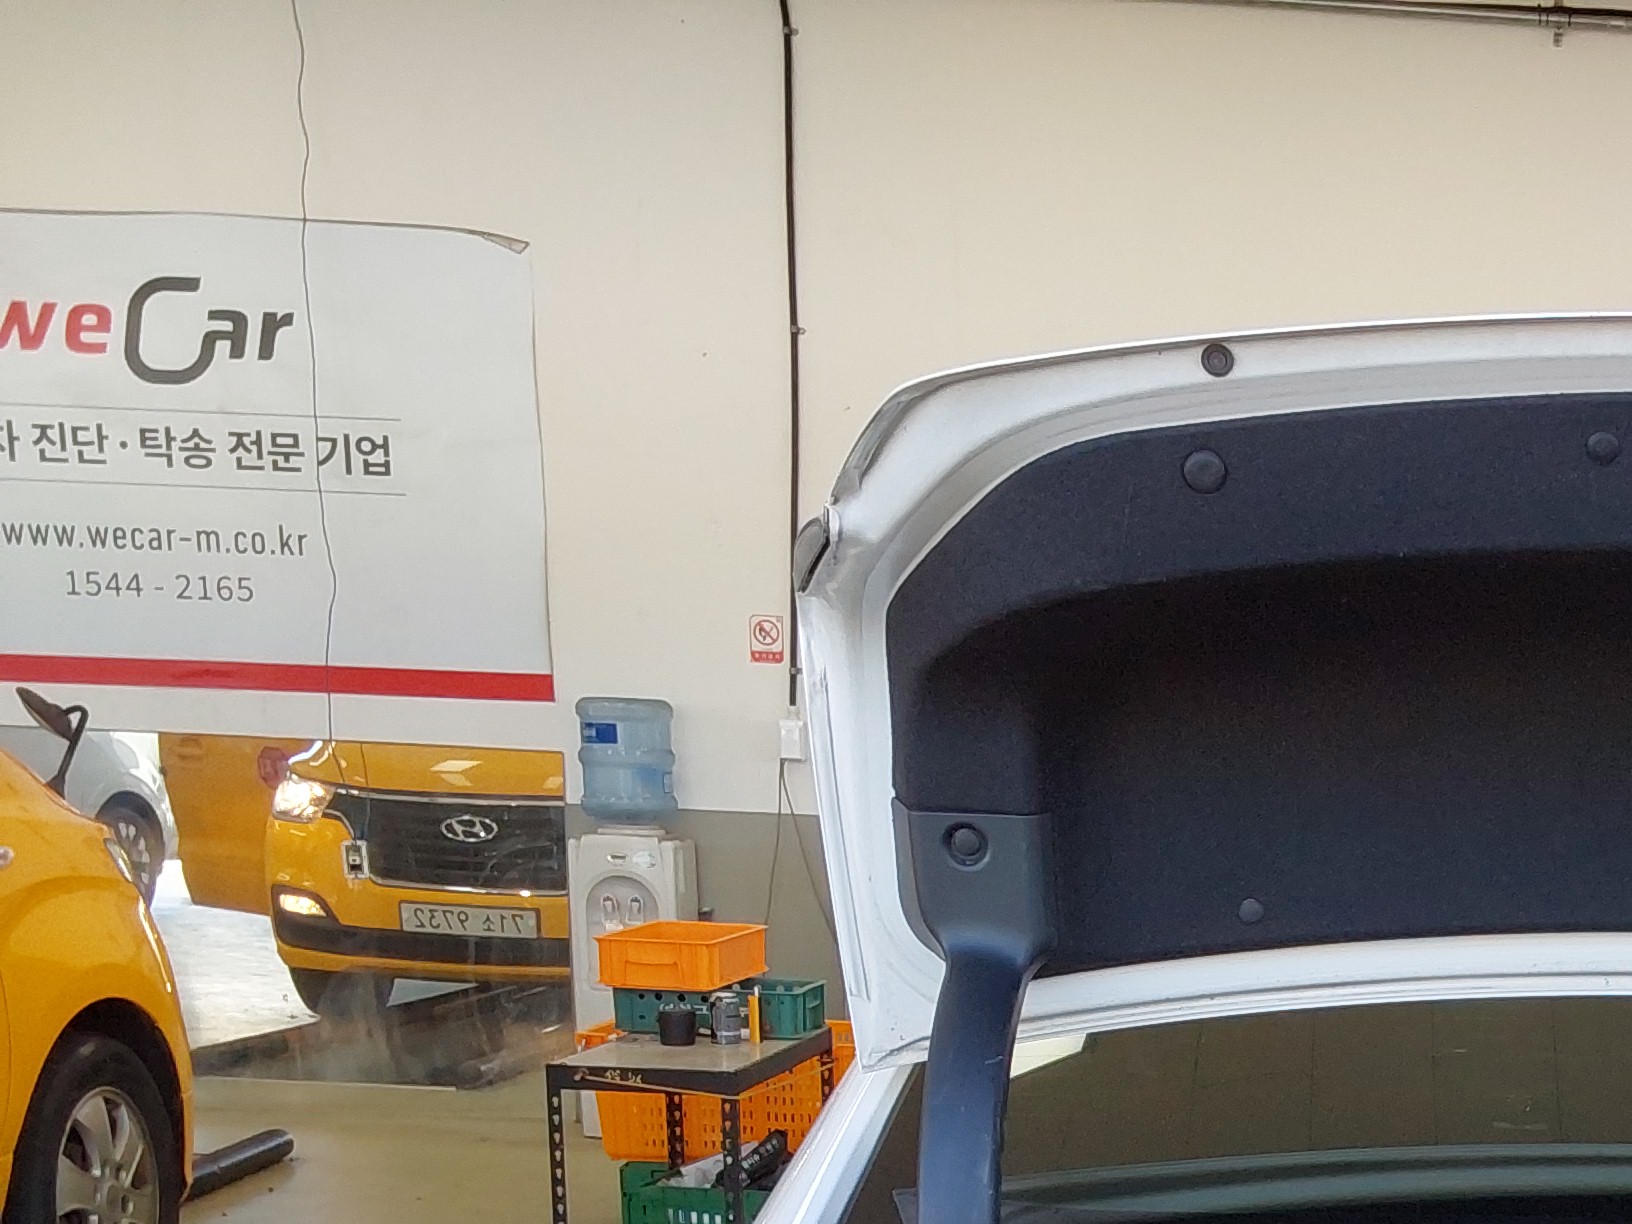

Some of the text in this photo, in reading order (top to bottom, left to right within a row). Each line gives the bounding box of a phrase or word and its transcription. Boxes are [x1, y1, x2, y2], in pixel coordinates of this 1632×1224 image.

[228, 430, 305, 472] 전문
[317, 433, 391, 477] 기업
[1, 522, 308, 556] www.wecar-m.co.kr
